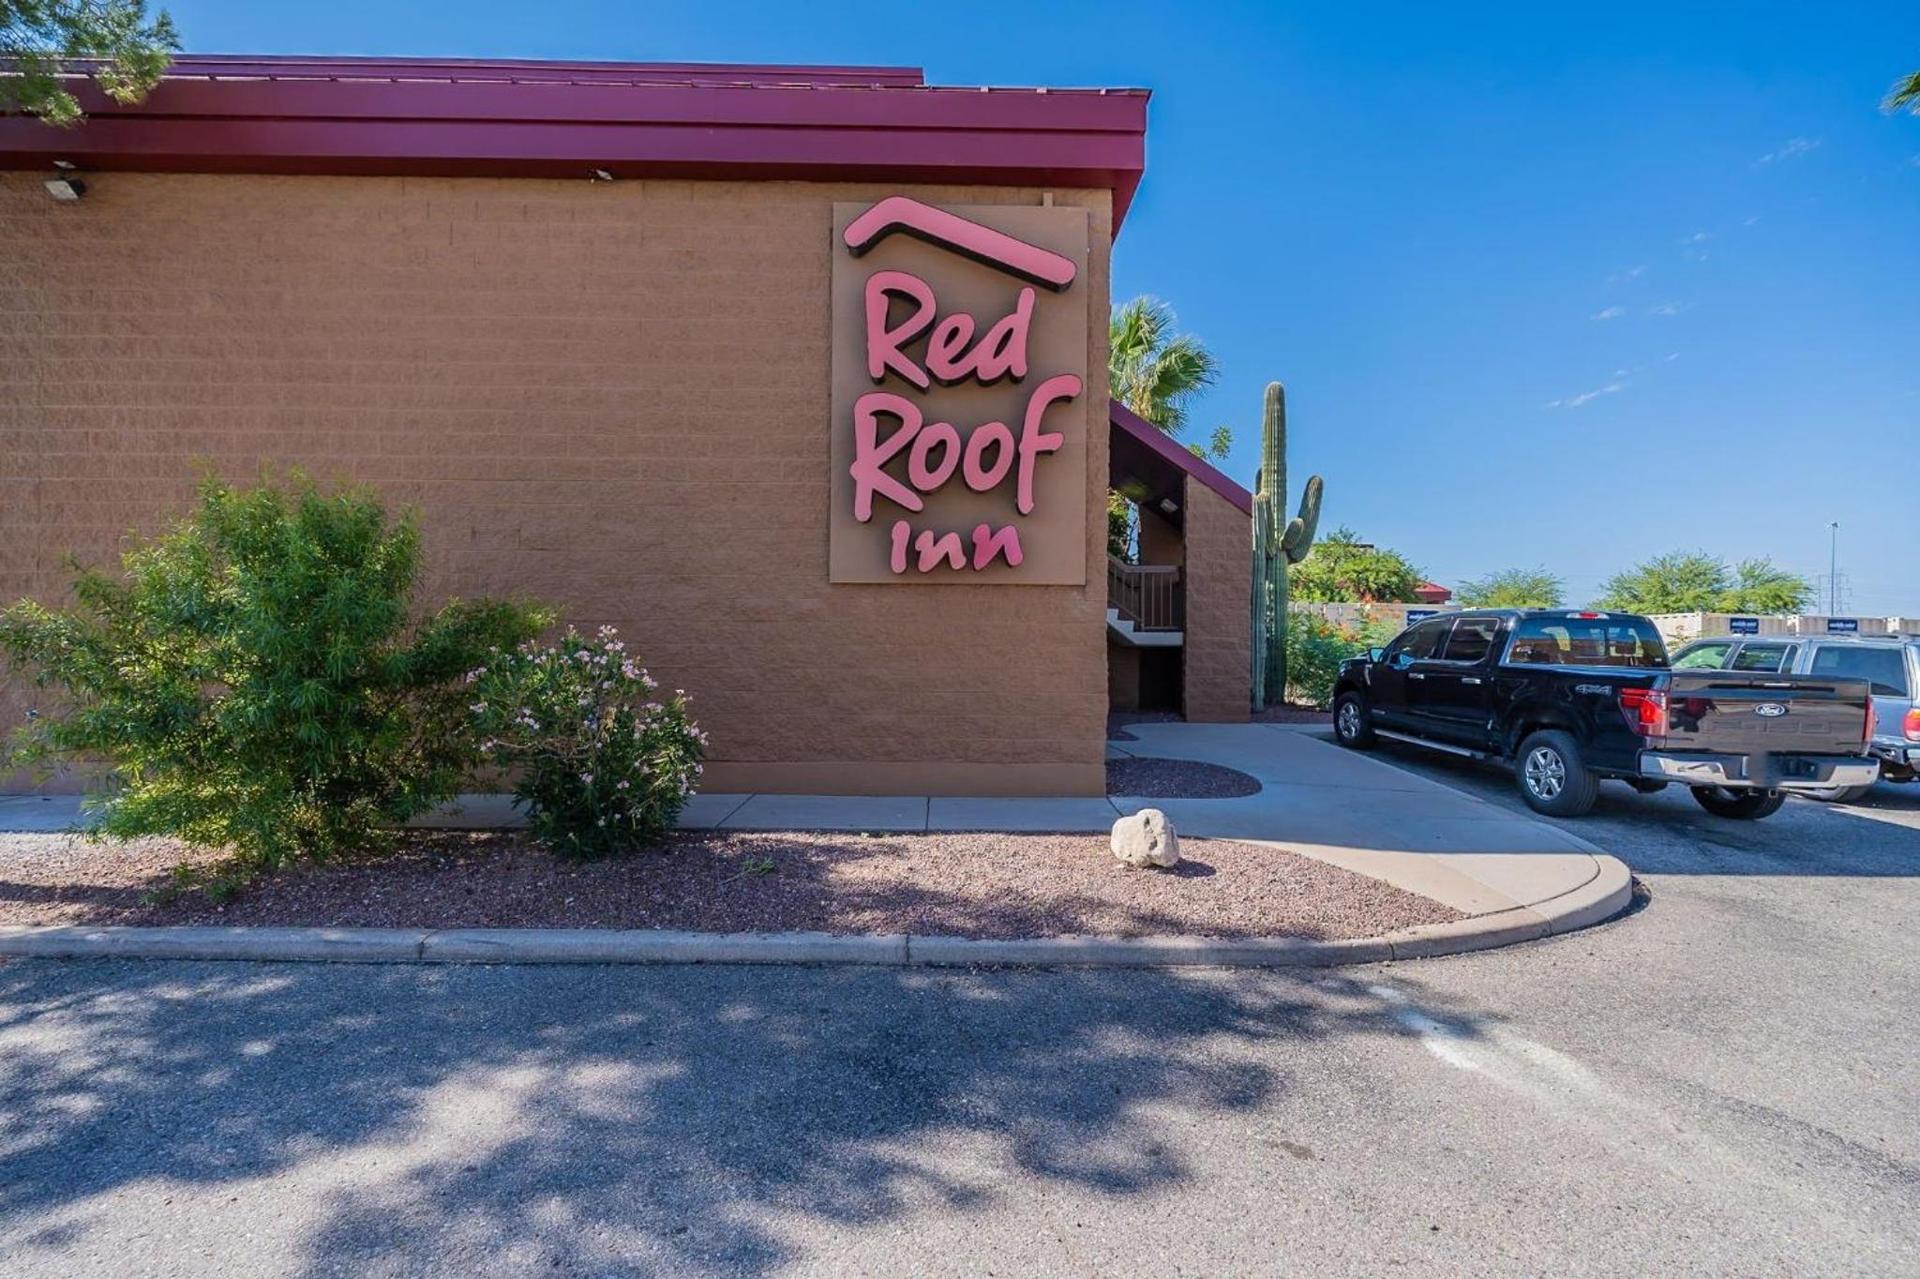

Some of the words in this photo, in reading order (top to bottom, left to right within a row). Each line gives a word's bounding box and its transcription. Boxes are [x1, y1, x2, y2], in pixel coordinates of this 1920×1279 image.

[864, 269, 1036, 390] Red
[849, 374, 1084, 523] Roof
[890, 520, 1025, 574] Inn
[1758, 705, 1781, 714] Ford
